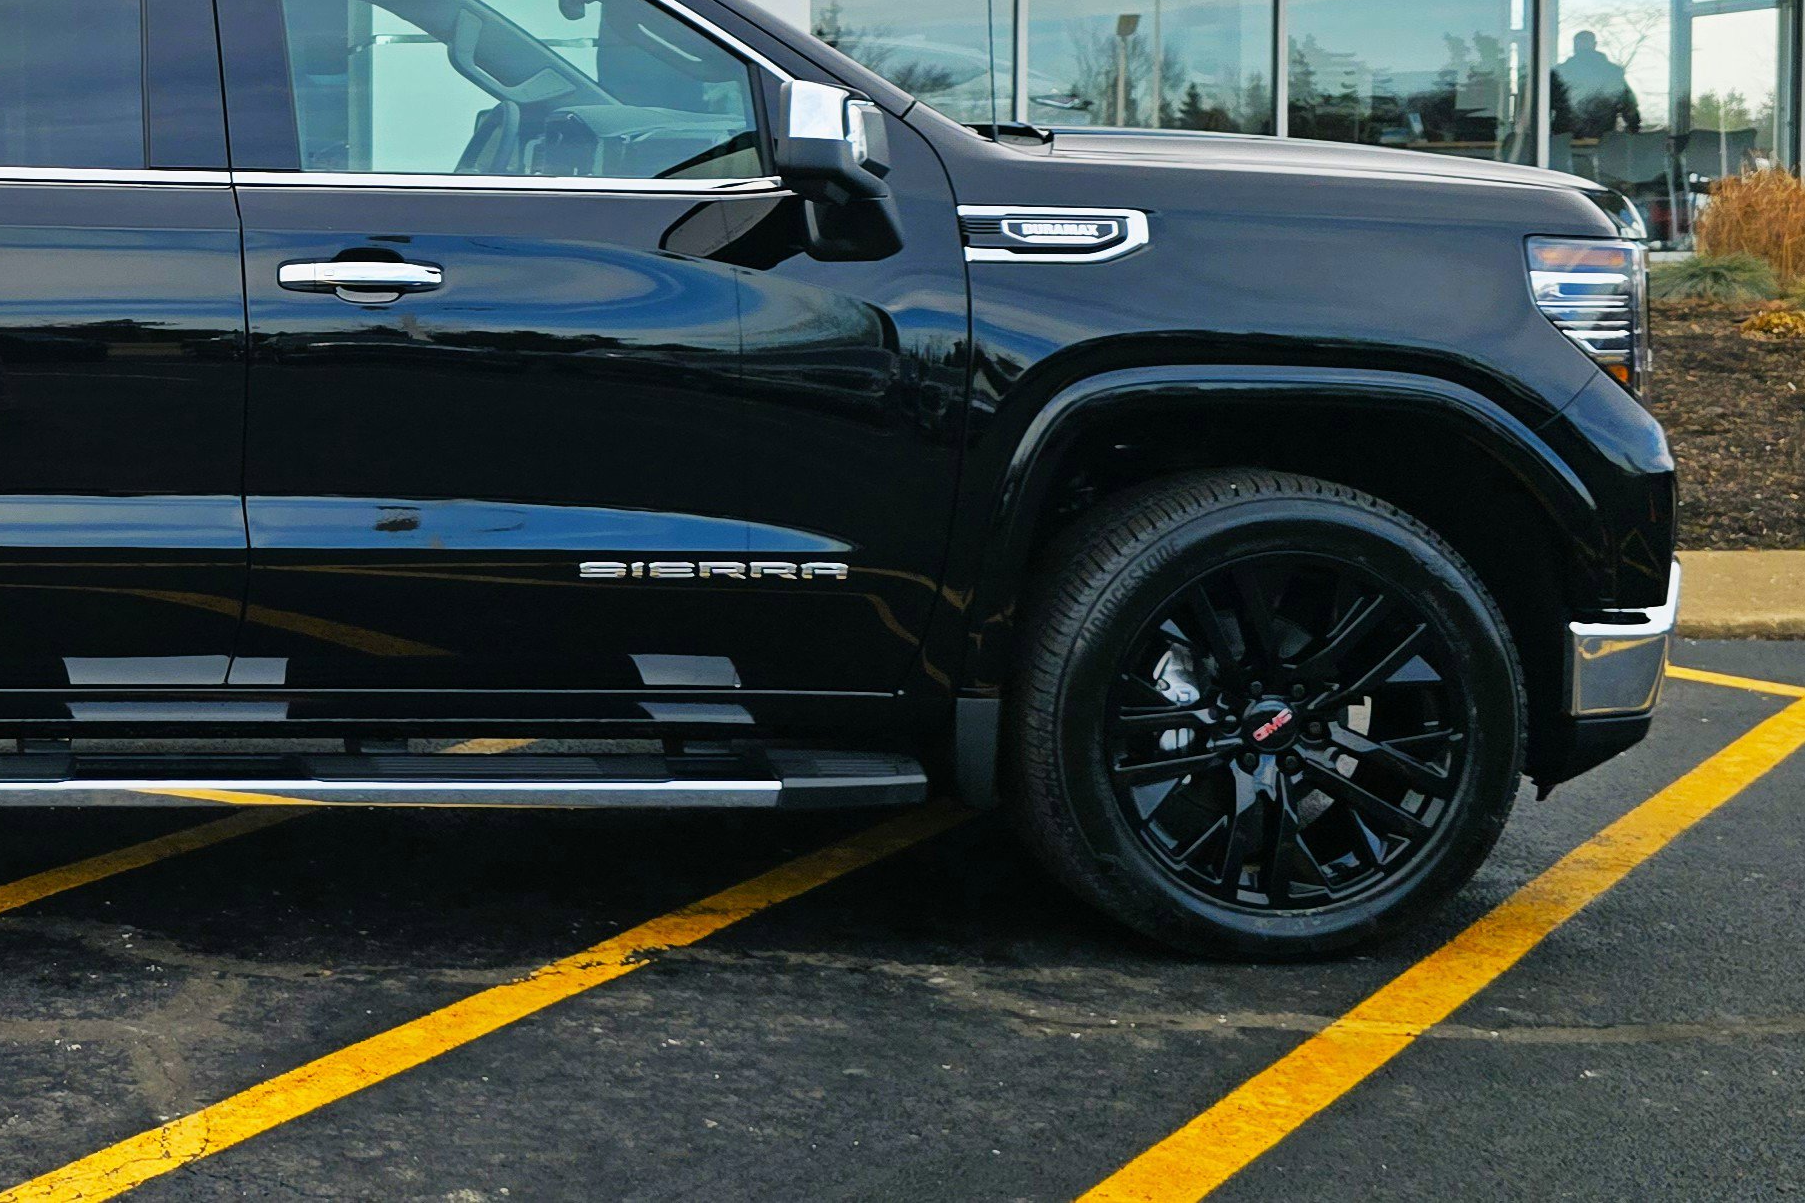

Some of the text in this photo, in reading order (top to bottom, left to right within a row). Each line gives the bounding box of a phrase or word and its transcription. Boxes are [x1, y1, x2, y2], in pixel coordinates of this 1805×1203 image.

[1021, 223, 1100, 237] DURAMAX
[579, 561, 849, 580] SIERRA
[1252, 707, 1293, 742] GMC
